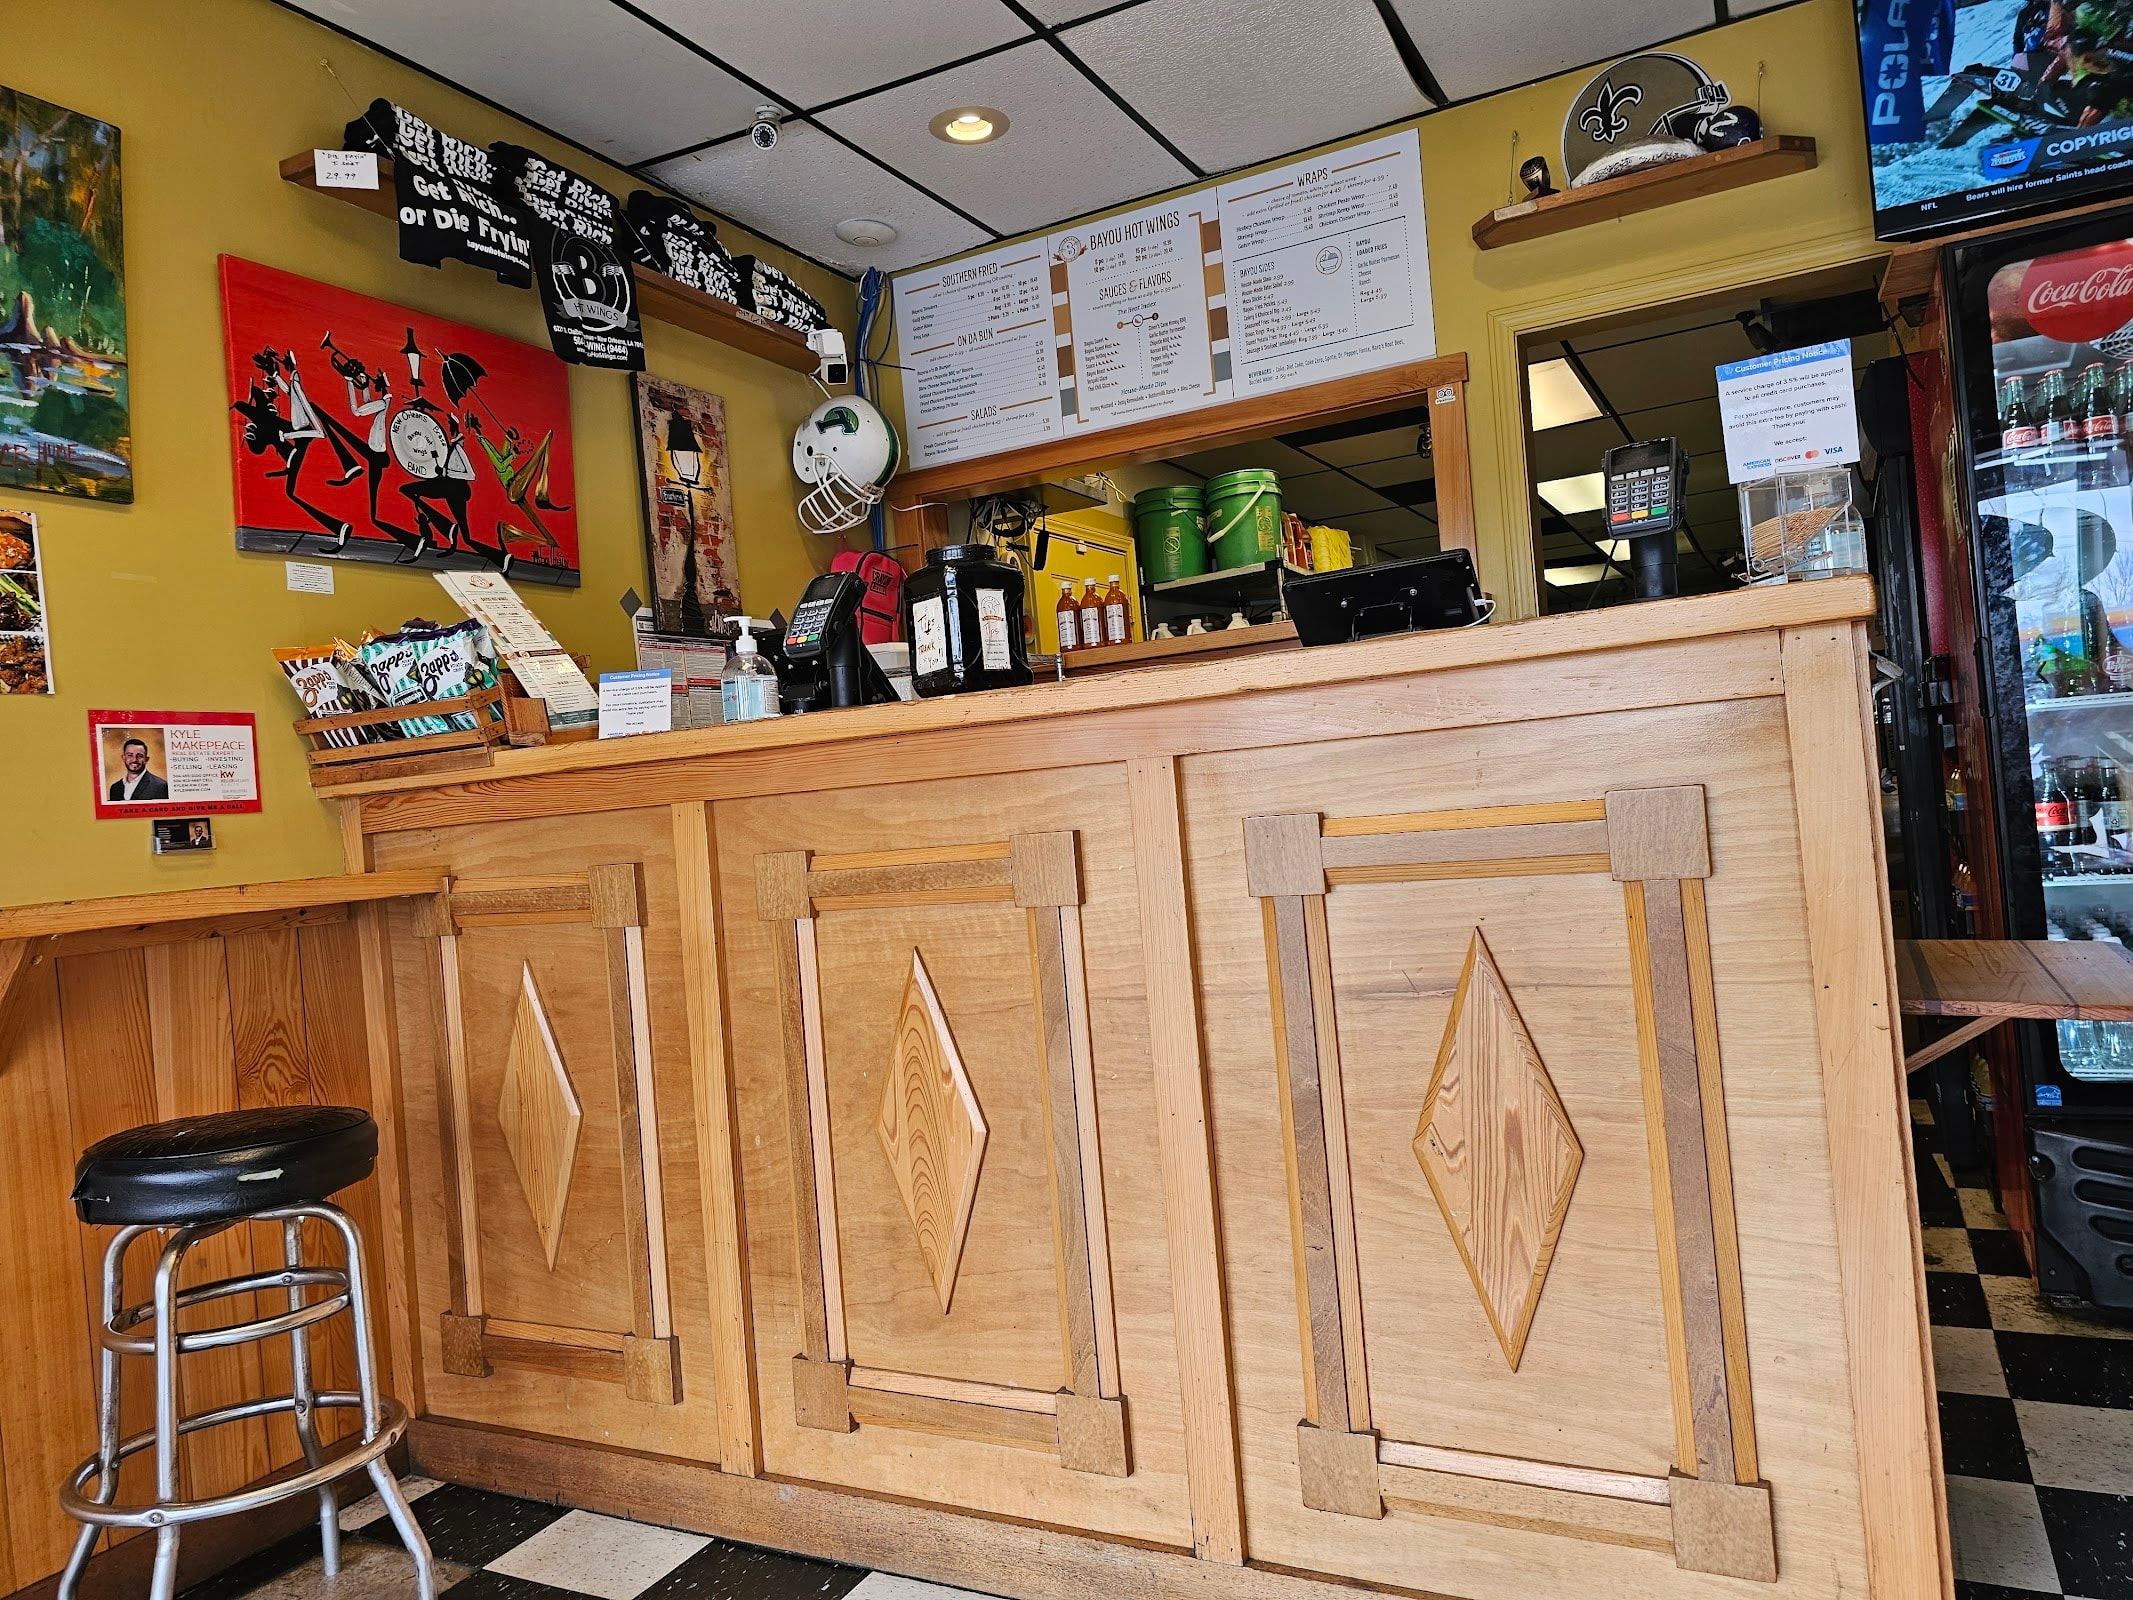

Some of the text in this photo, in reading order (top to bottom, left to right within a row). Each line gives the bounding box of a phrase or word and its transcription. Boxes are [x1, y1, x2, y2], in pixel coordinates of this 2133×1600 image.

[1999, 72, 2017, 90] 31
[2046, 126, 2133, 157] COPYRIG
[326, 172, 356, 180] 29.99
[1297, 167, 1327, 187] WRAPS
[1966, 191, 1990, 202] Bears
[1990, 185, 2005, 196] will
[2006, 182, 2024, 193] hire
[2025, 177, 2054, 189] former
[2055, 170, 2083, 182] Saints
[2084, 164, 2106, 176] head
[413, 175, 452, 201] Get
[1317, 200, 1336, 210] Chicken
[1351, 192, 1365, 201] Wrap
[1920, 201, 1939, 212] NFL
[400, 206, 530, 256] or Die Fryin'
[1090, 228, 1122, 250] BAYOU
[1124, 222, 1142, 240] HOT
[1145, 210, 1180, 235] WINGS
[1318, 217, 1338, 227] Chicken
[1251, 238, 1264, 246] Wrap
[942, 262, 998, 287] SOUTHERN FRIED
[1239, 261, 1274, 278] BAYOU SIDES
[1098, 282, 1126, 300] SAUCES
[1138, 270, 1172, 290] FLAVORS
[2027, 263, 2133, 314] Coca-Cola
[586, 304, 619, 321] WINGS
[957, 327, 993, 346] ON DA BUN
[1735, 348, 1826, 373] Customer Pricing Notice
[1753, 381, 1774, 391] charge
[1820, 367, 1844, 378] applied
[1793, 398, 1825, 408] customers
[970, 405, 997, 420] SALADS
[1794, 409, 1814, 417] paying
[392, 416, 403, 435] NEW
[1772, 421, 1791, 429] Thank
[1743, 446, 1842, 466] AMERICAN DISCOVER VISA
[407, 461, 427, 476] BAND
[170, 730, 200, 739] KYLE
[171, 741, 245, 750] MAKEPEACE
